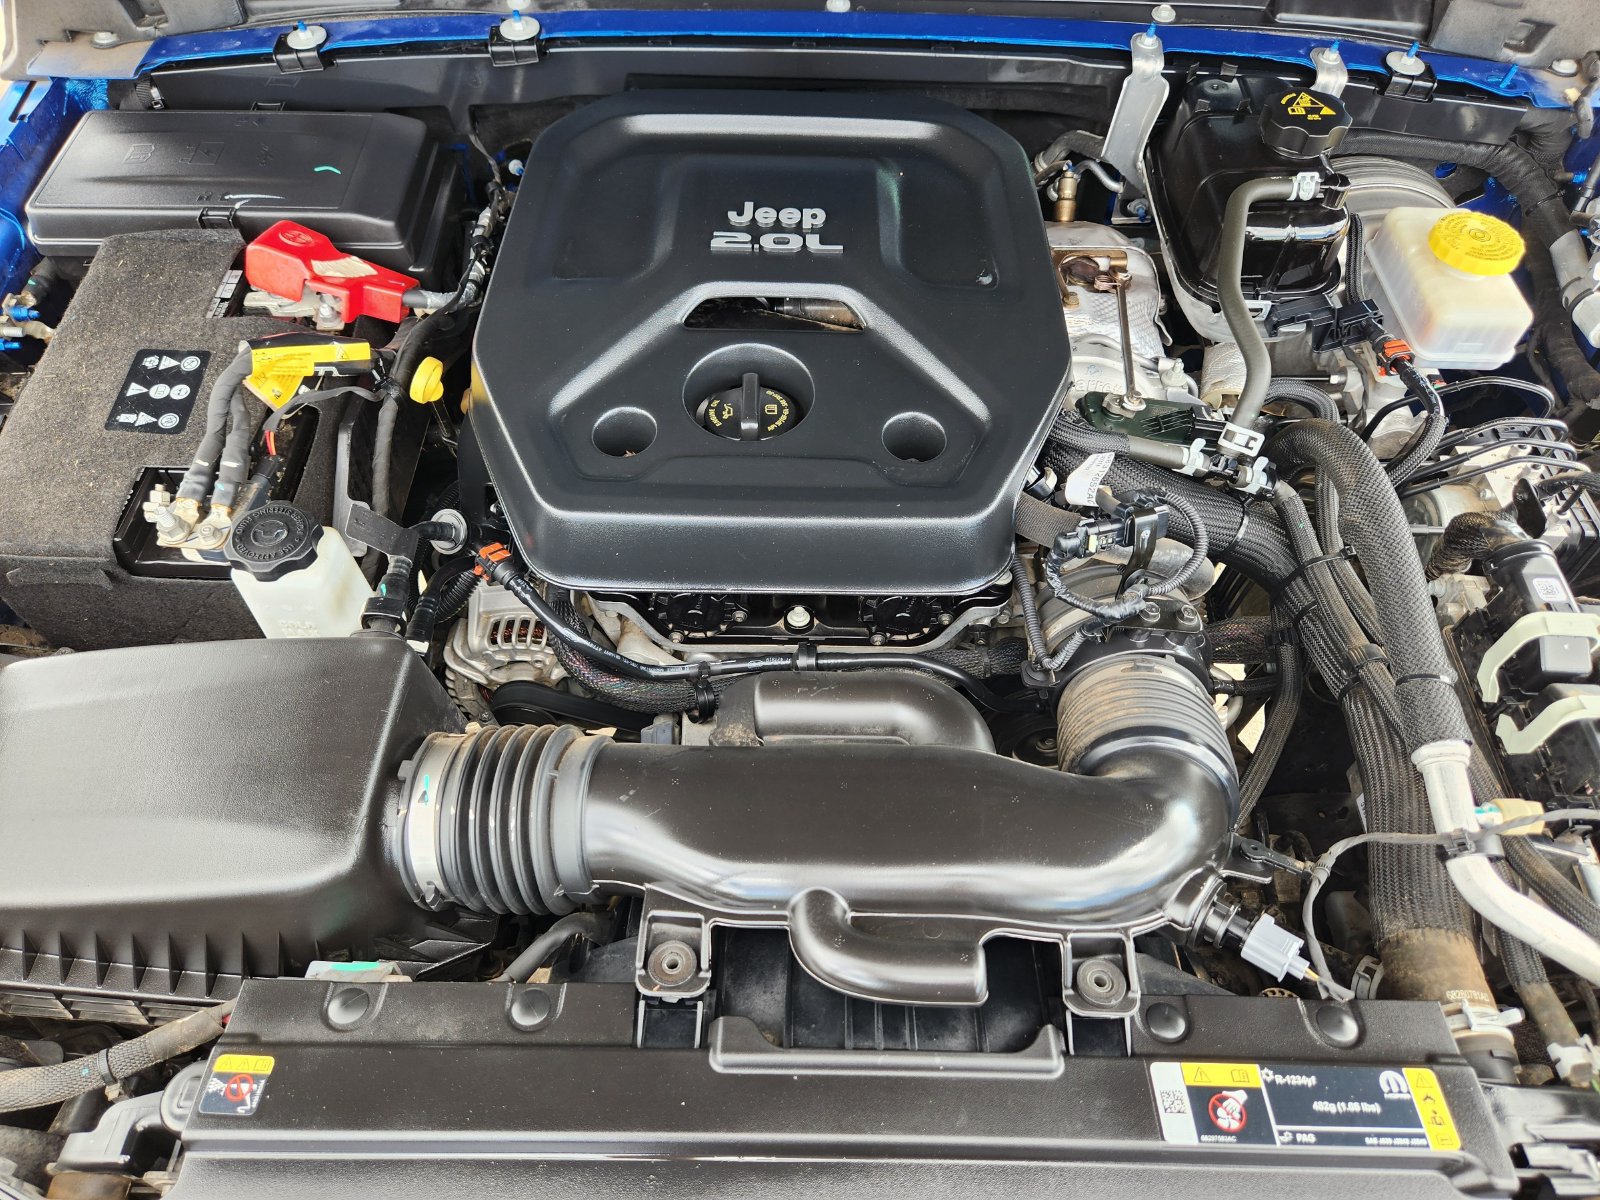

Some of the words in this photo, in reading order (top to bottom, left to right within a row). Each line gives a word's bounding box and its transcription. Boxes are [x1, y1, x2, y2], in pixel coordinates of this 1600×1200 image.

[728, 201, 827, 232] Jeep
[710, 231, 844, 254] 2.0L
[709, 409, 722, 427] ENGINE
[252, 506, 292, 518] STEERING
[235, 516, 254, 535] FLUID
[290, 511, 306, 535] POWER
[236, 543, 277, 561] APPROVED
[278, 543, 296, 556] USE
[1274, 1074, 1317, 1088] R-1234yf
[1295, 1133, 1317, 1144] PAG
